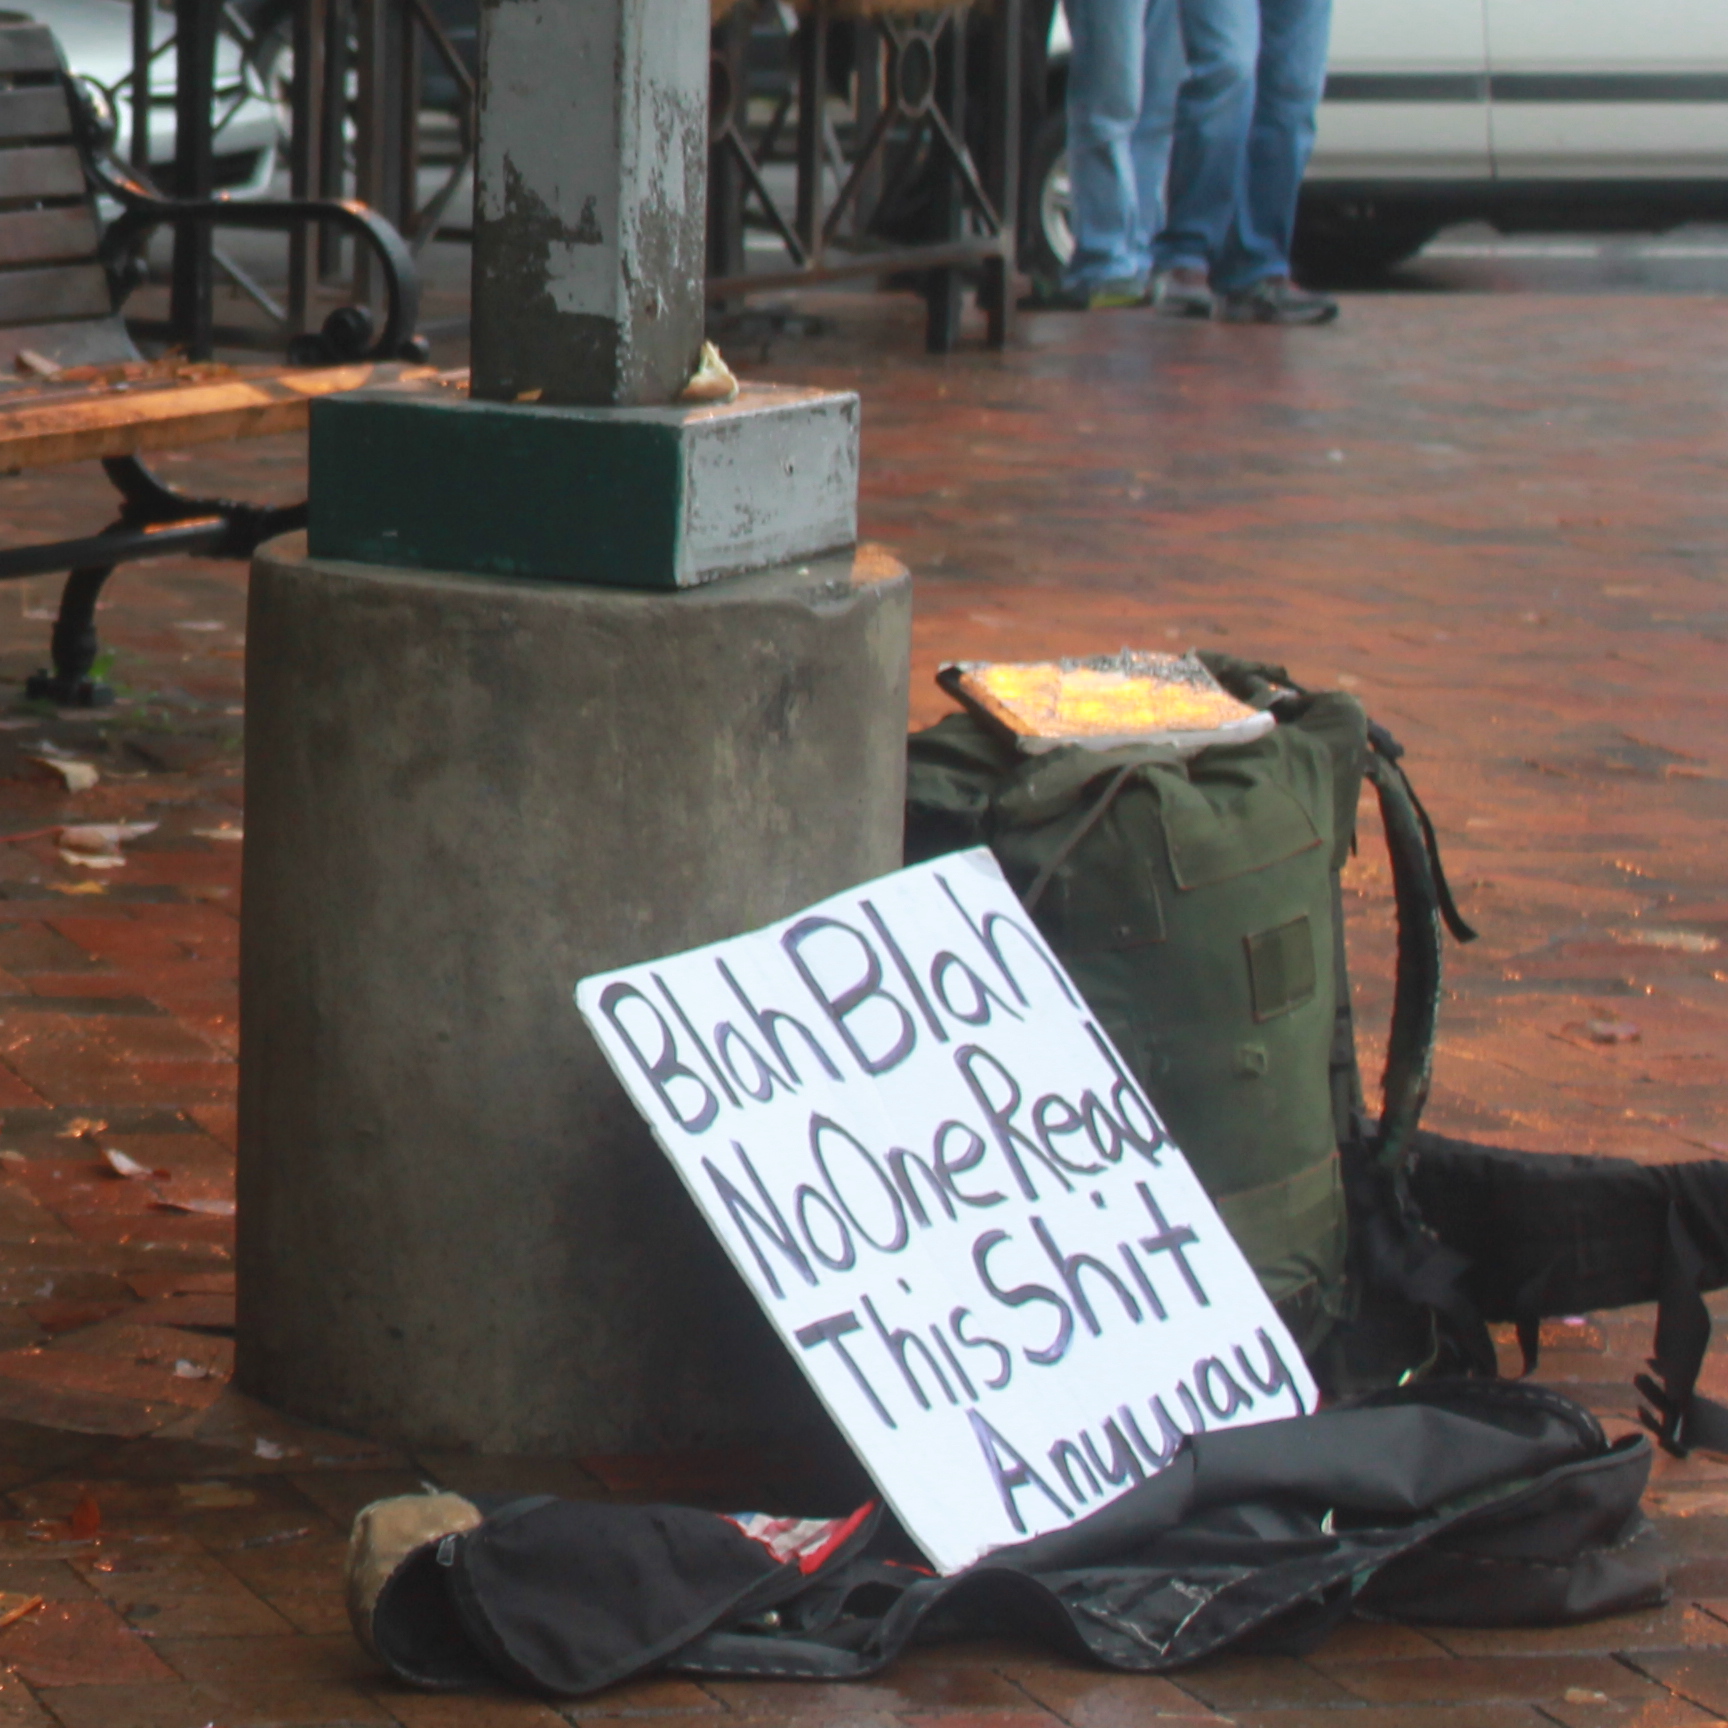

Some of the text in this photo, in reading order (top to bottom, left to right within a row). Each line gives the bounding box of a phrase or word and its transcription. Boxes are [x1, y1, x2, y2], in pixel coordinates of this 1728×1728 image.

[598, 871, 1082, 1134] Blah Blah
[953, 1019, 1179, 1203] Read
[792, 1180, 1202, 1429] This Shit
[963, 1325, 1309, 1534] Anyway
